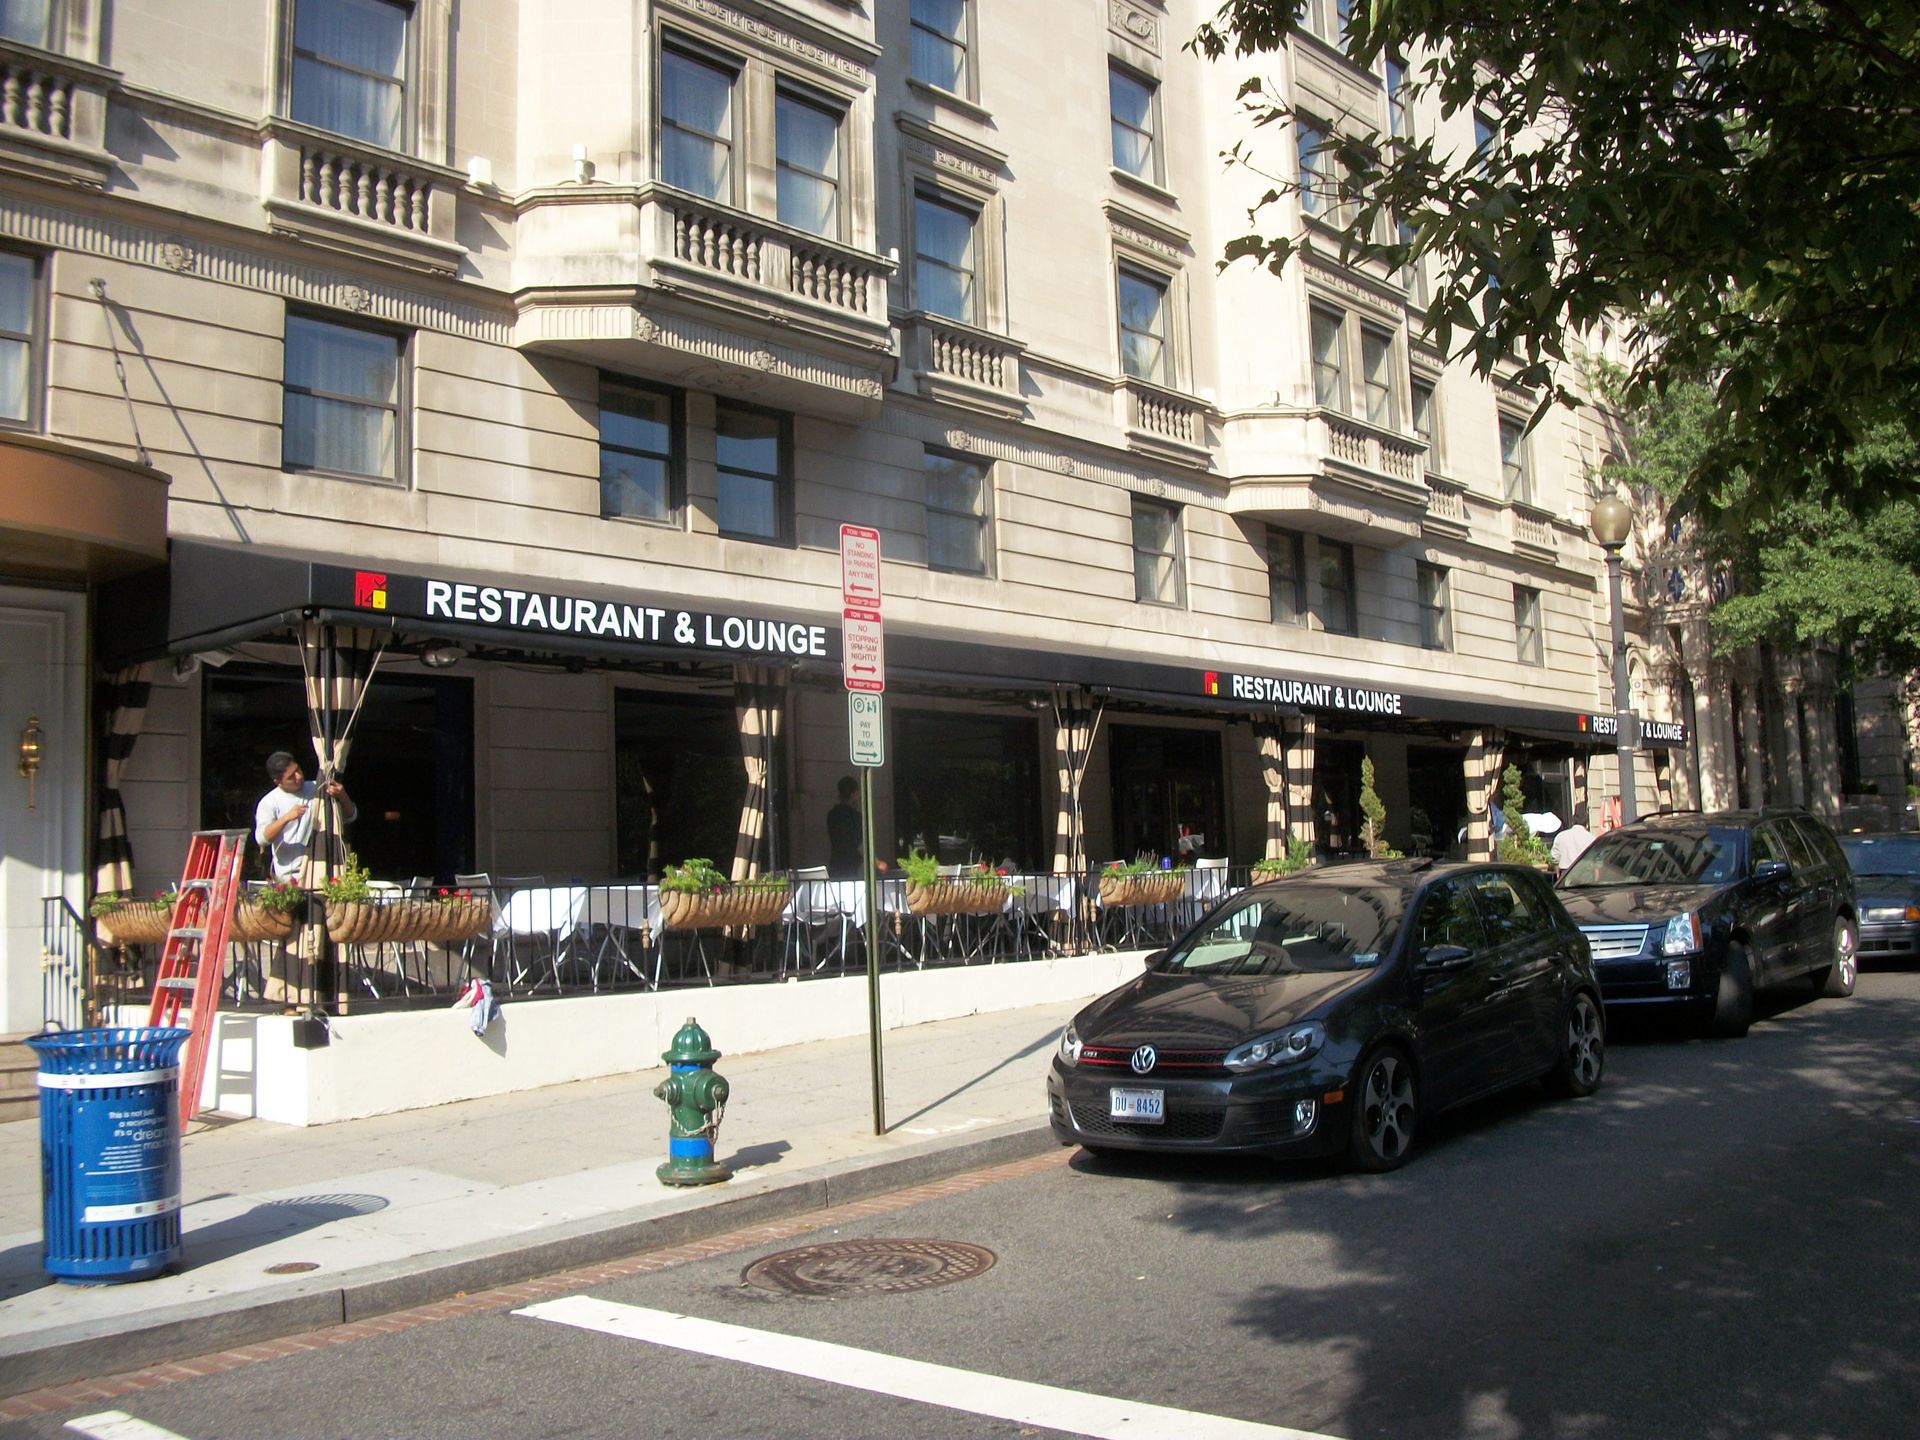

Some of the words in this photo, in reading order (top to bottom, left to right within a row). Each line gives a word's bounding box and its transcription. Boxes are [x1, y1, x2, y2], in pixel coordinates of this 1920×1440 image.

[847, 549, 875, 560] STANDING
[853, 560, 876, 569] PARKING
[426, 580, 666, 641] RESTAURANT
[673, 611, 696, 645] &
[705, 614, 827, 656] LOUNGE
[848, 633, 879, 644] STOPPING
[851, 652, 877, 662] NIGHTLY
[1232, 674, 1332, 707] RESTAURANT
[1334, 687, 1345, 709] &
[1348, 688, 1402, 715] LOUNGE
[860, 721, 871, 729] PAY
[862, 731, 871, 739] TO
[1646, 724, 1652, 738] &
[1653, 723, 1683, 740] LOUNGE
[857, 740, 874, 748] PARK
[1136, 1099, 1160, 1114] 8452
[109, 1111, 122, 1119] This
